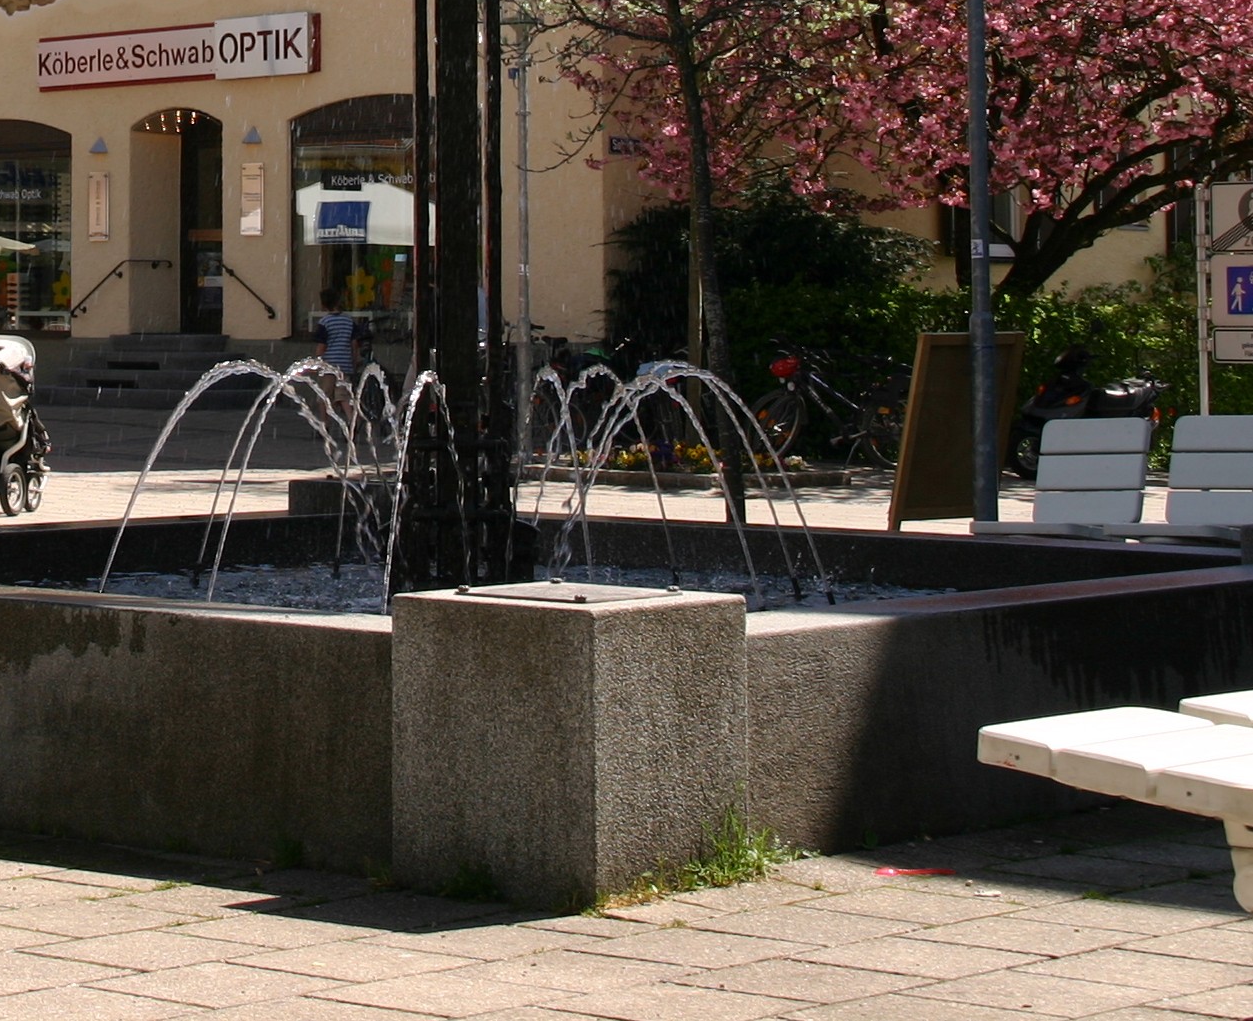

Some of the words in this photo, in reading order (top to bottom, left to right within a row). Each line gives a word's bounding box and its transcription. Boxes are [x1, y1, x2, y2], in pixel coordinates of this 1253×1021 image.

[38, 39, 214, 76] Köberle&Schwab
[218, 27, 303, 64] OPTIK
[378, 173, 414, 184] Schwab
[21, 188, 41, 200] Optik
